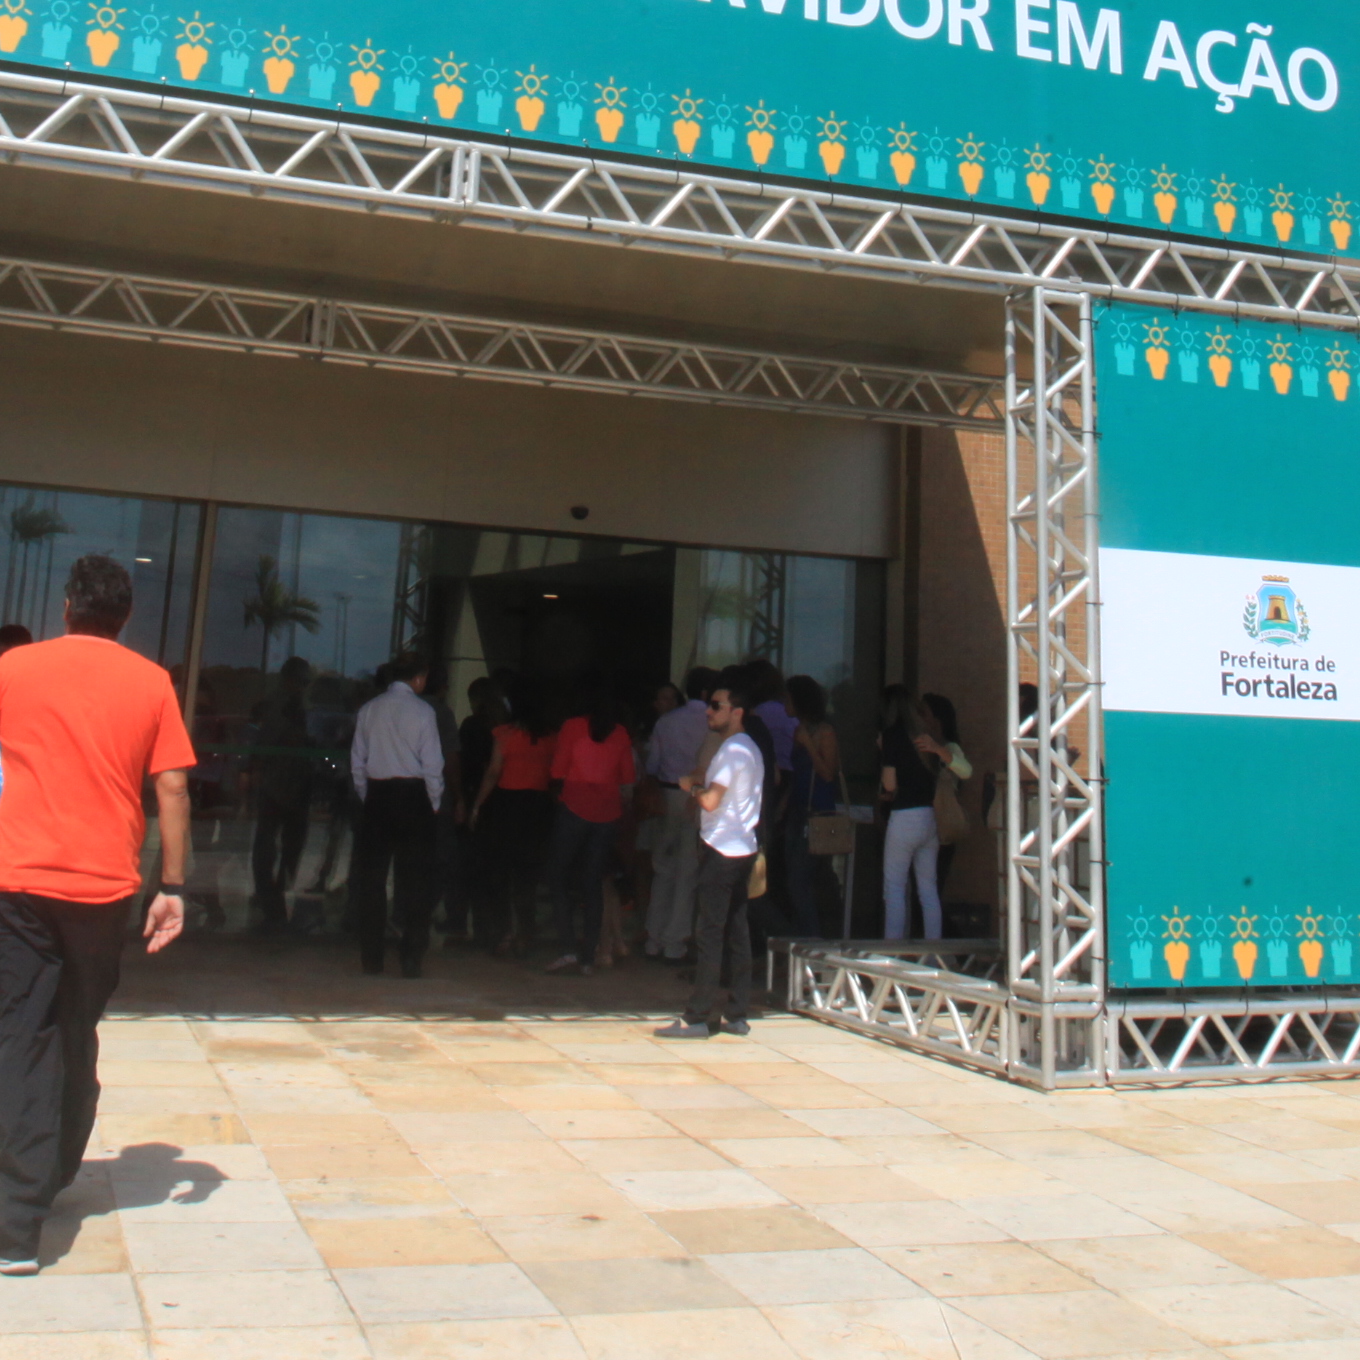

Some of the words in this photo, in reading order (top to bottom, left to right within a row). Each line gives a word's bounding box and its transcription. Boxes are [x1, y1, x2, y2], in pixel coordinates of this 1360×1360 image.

[1142, 21, 1340, 115] AÇÃO
[1220, 650, 1309, 671] Prefeitura
[1315, 655, 1336, 672] de
[1221, 672, 1338, 701] Fortaleza
